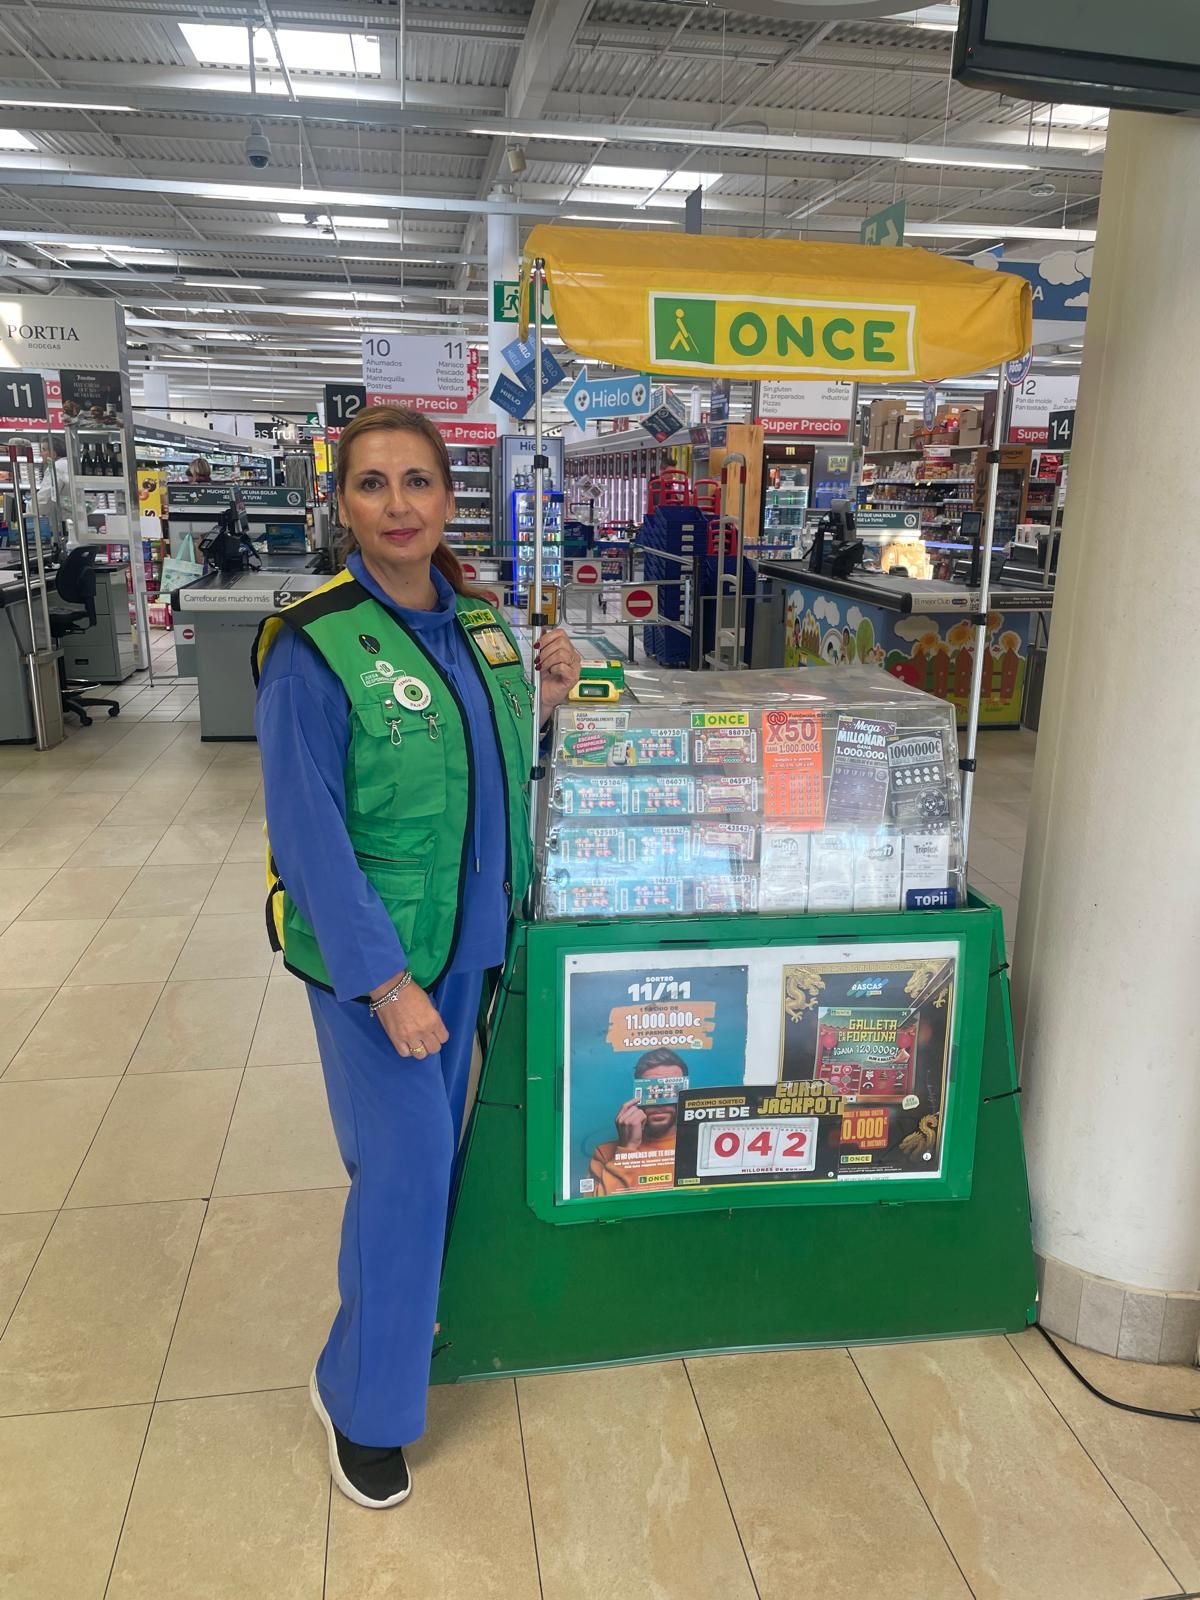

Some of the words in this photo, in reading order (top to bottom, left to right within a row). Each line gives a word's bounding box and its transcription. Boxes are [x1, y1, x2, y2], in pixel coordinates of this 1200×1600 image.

[8, 325, 80, 341] PORTIA
[729, 311, 896, 362] ONCE
[365, 339, 391, 356] 10
[444, 342, 463, 360] 11
[366, 359, 402, 367] Ahumados
[366, 375, 405, 383] Mantequilla
[1020, 380, 1036, 395] 12
[7, 382, 33, 408] 11
[500, 388, 521, 406] HIELO
[592, 389, 630, 409] Hielo
[333, 395, 361, 418] 12
[373, 396, 414, 408] Super
[416, 398, 458, 410] Precio
[761, 419, 798, 433] Super
[800, 420, 841, 431] Precio
[1051, 419, 1070, 440] 14
[455, 428, 496, 440] Precio
[1017, 429, 1048, 442] Super
[520, 441, 548, 452] Hieo
[228, 594, 254, 603] mucho
[254, 595, 270, 603] más
[708, 714, 745, 725] ONCE
[854, 721, 882, 734] Mega
[837, 730, 886, 747] MILLONARI
[628, 981, 691, 1002] 11/11
[851, 983, 882, 991] RASCAS
[625, 1012, 701, 1030] 11.000.000€
[849, 1019, 897, 1031] GALLETA
[624, 1035, 694, 1047] 1.000.000€
[847, 1031, 896, 1042] FORTUNA
[687, 1099, 717, 1107] PRÓXIMO
[757, 1097, 841, 1115] JACKPOT
[684, 1107, 726, 1121] BOTE
[728, 1107, 750, 1117] DE
[648, 1174, 670, 1182] ONCE
